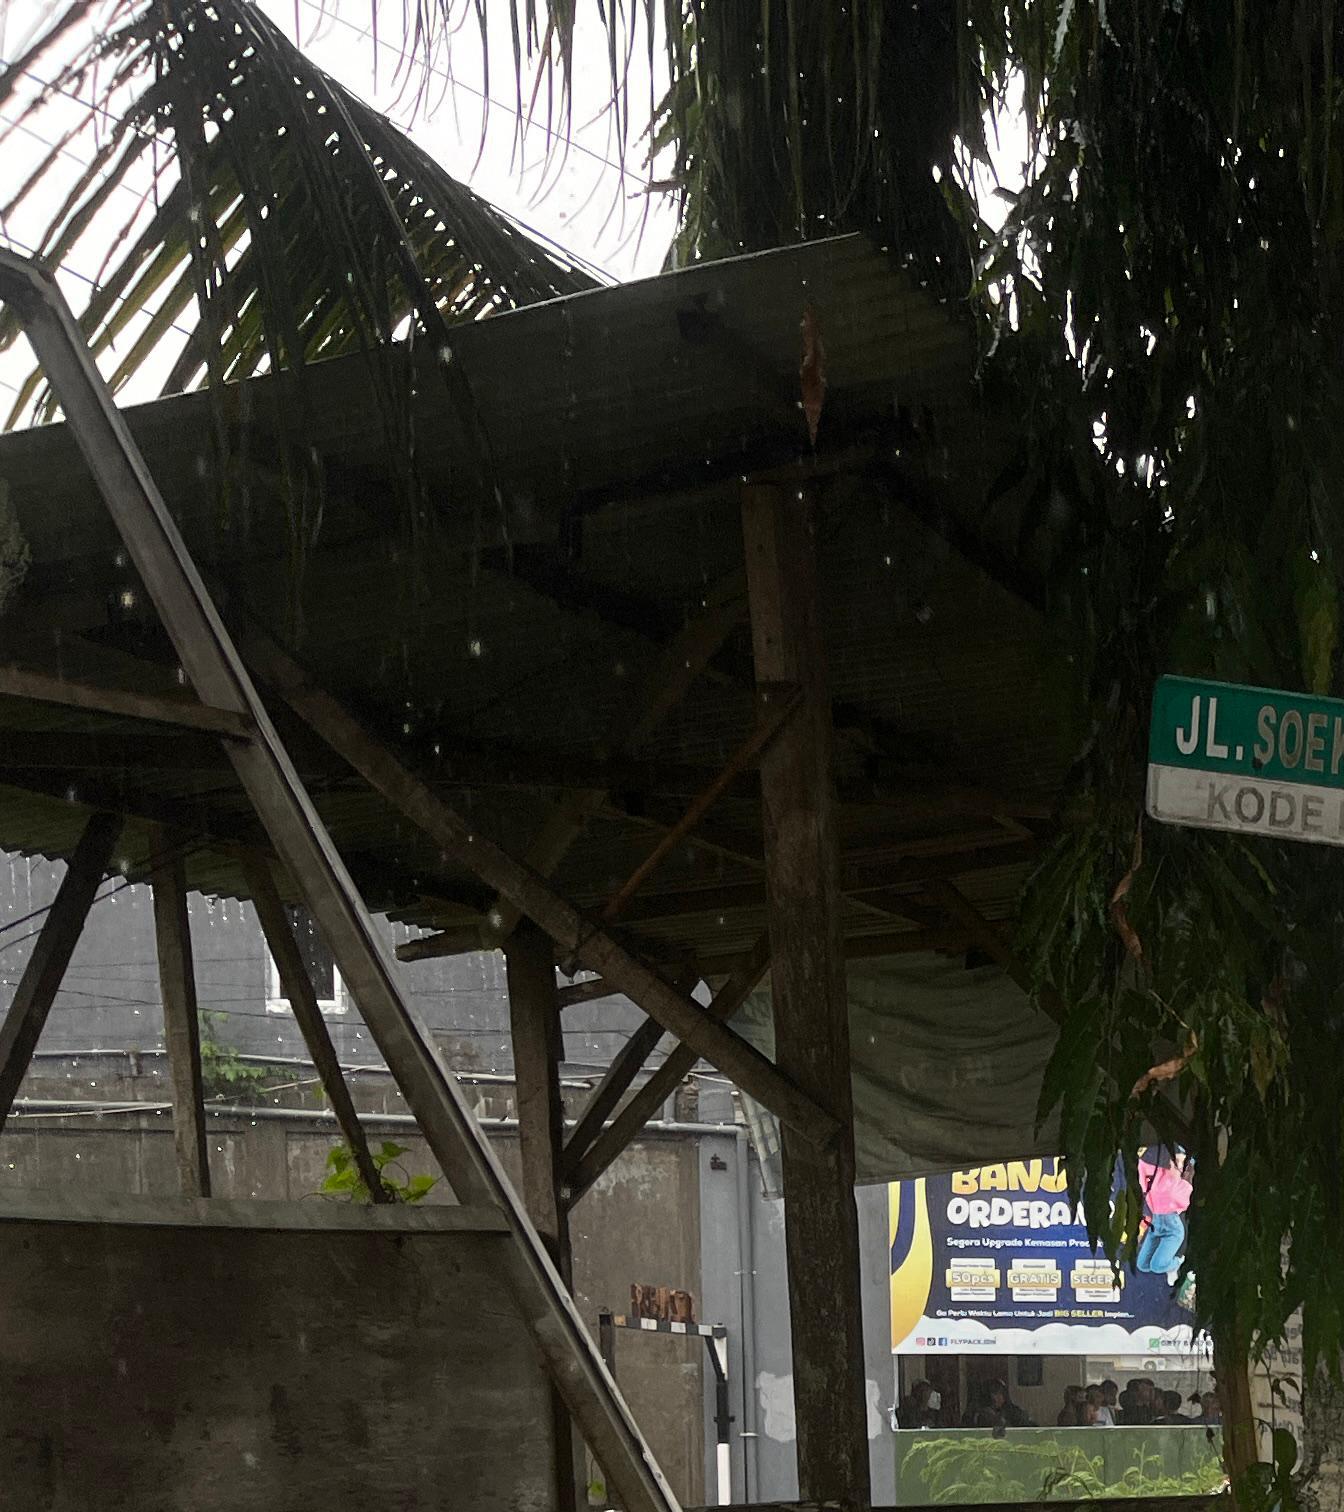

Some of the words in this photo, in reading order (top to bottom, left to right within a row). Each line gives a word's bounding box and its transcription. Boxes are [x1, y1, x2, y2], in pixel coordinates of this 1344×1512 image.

[1207, 782, 1325, 832] KODE
[1010, 1273, 1060, 1284] GRATIS
[1073, 1273, 1119, 1284] SEGER
